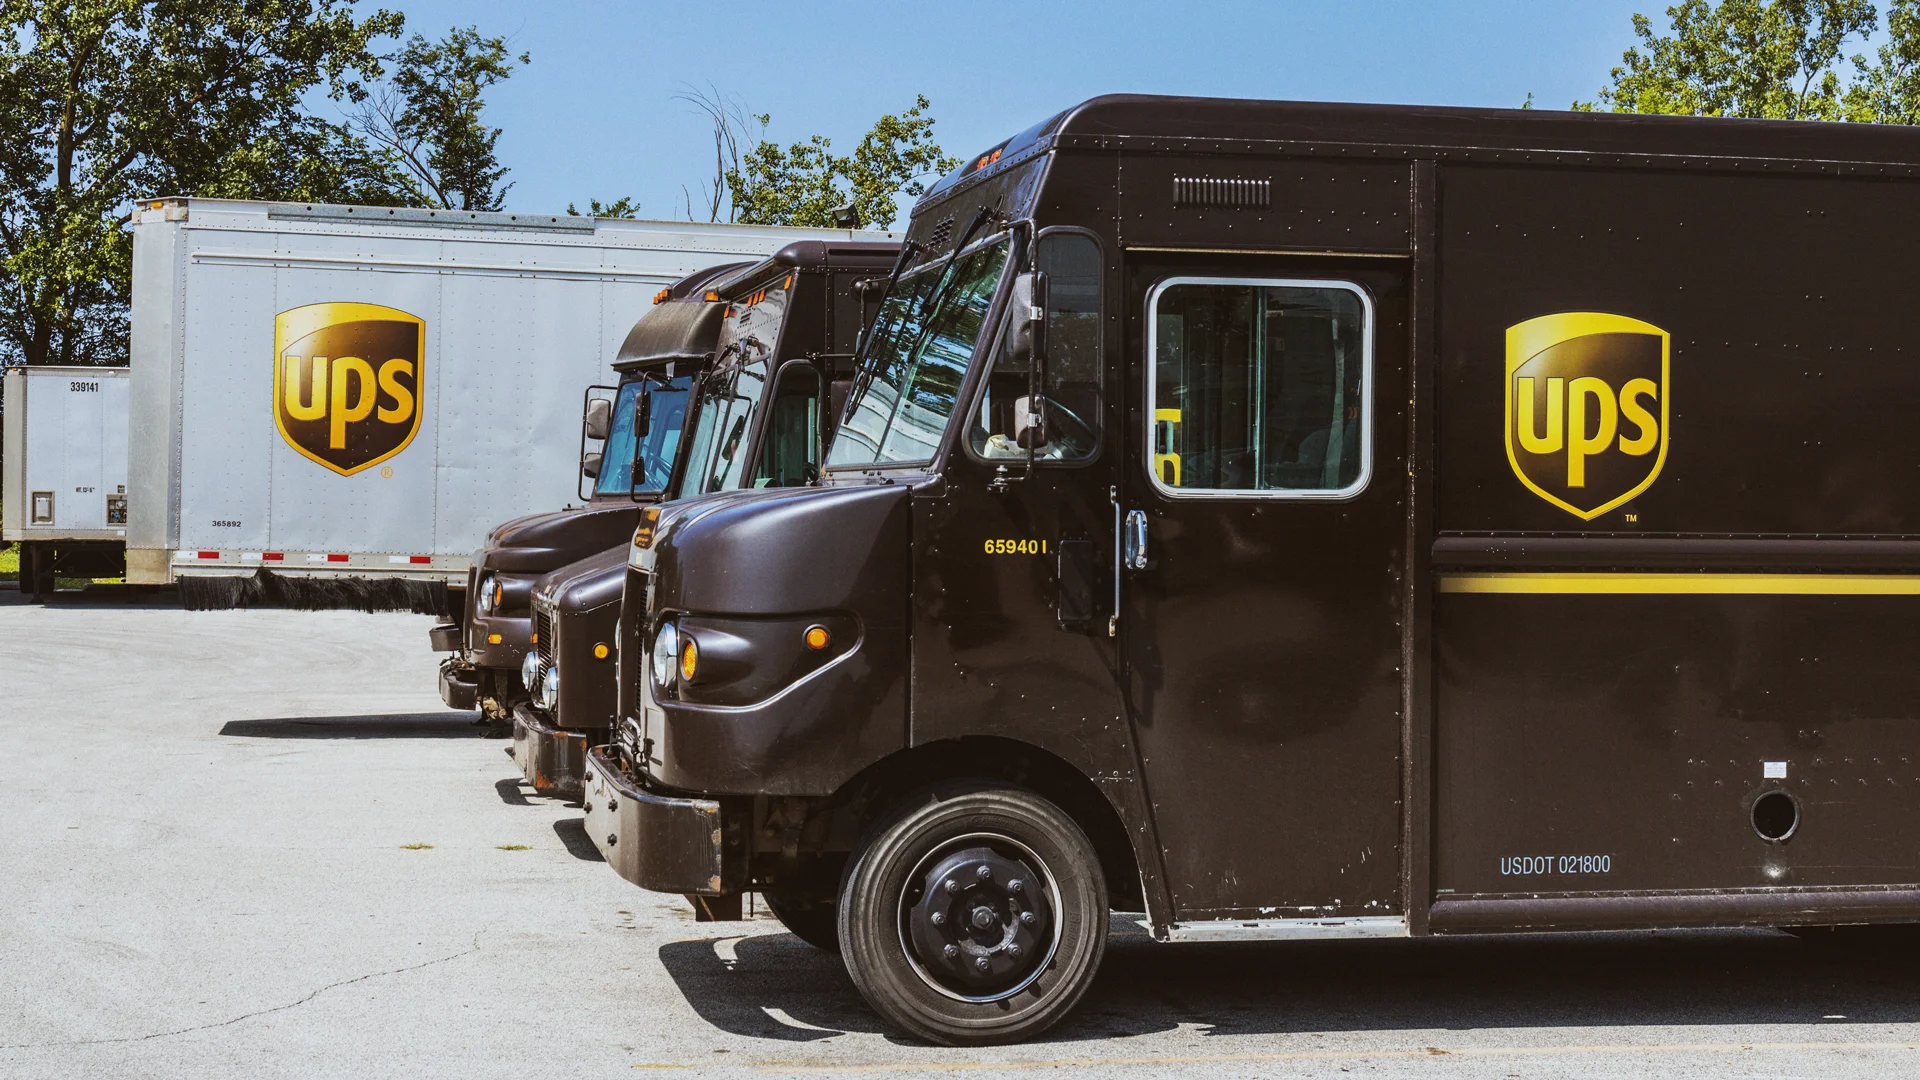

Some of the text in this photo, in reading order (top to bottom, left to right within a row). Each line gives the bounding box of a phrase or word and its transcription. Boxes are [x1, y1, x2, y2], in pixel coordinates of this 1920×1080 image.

[70, 381, 99, 392] 339141
[211, 520, 242, 528] 365892
[984, 539, 1047, 554] 659401
[1501, 855, 1611, 875] USDOT 021800
